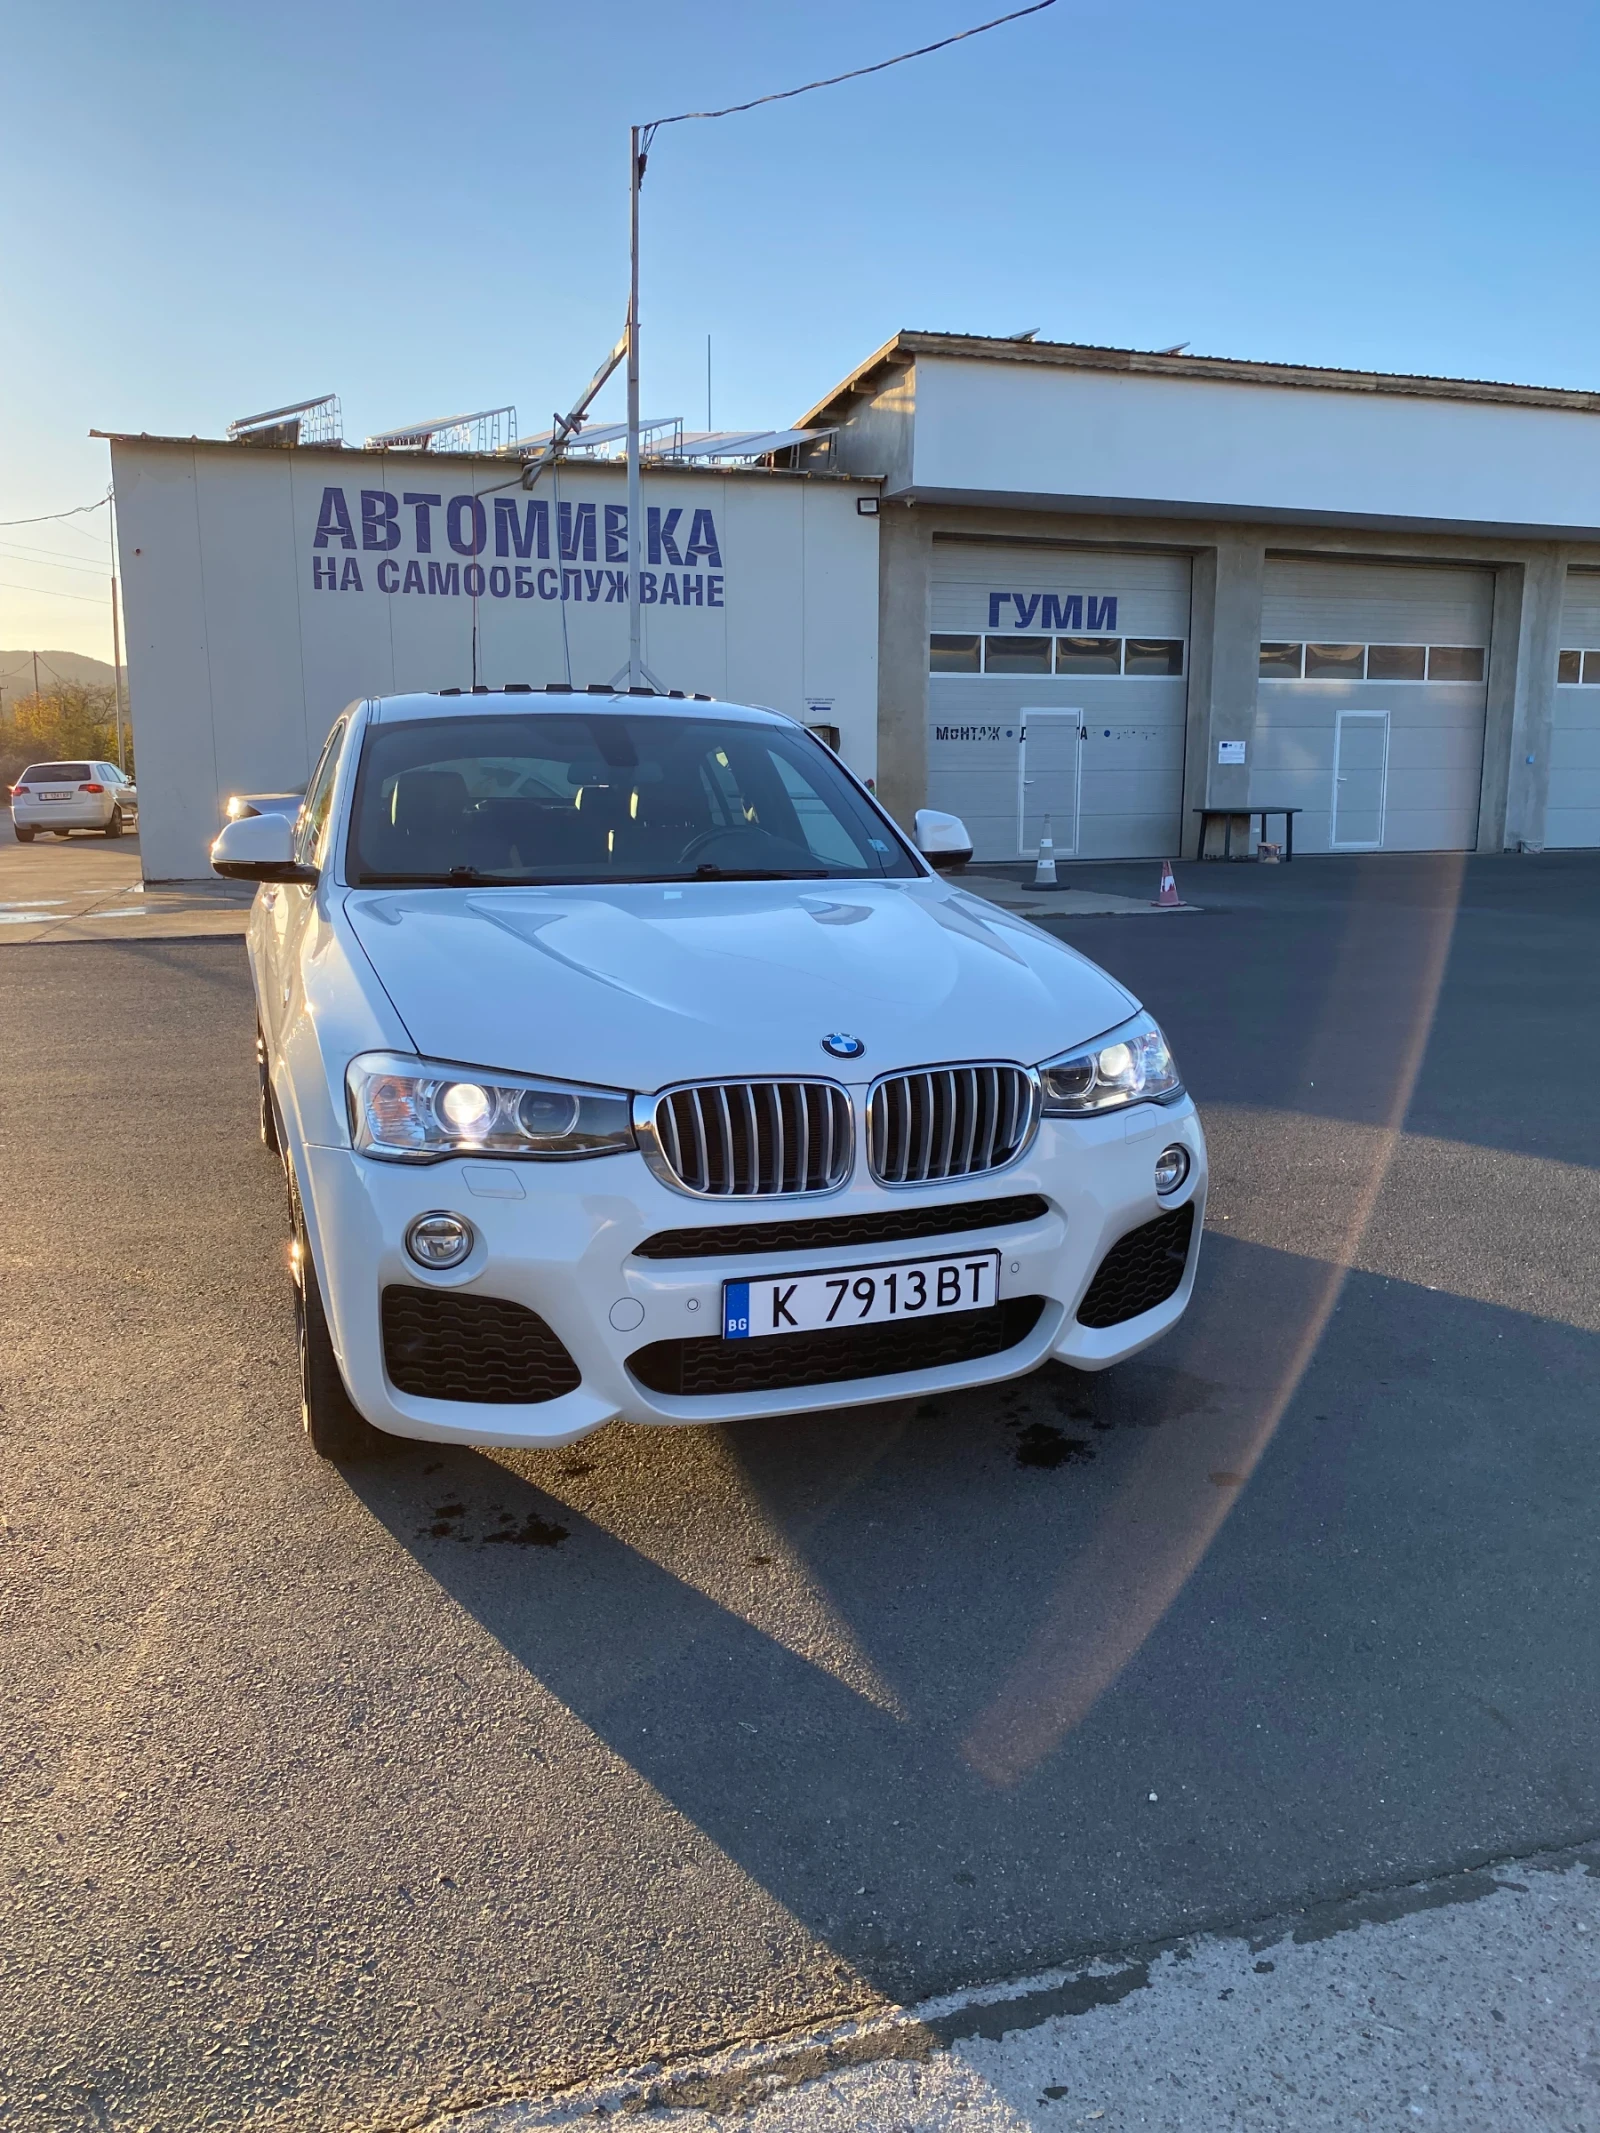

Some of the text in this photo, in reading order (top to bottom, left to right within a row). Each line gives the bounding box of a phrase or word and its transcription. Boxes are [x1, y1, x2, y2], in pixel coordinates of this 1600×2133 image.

[313, 486, 722, 568] АВТОМИВКА
[312, 555, 725, 608] НА САМООБСЛУЖВАНЕ
[988, 592, 1118, 631] ГУМИ
[728, 1318, 747, 1332] BG
[772, 1284, 798, 1328] K
